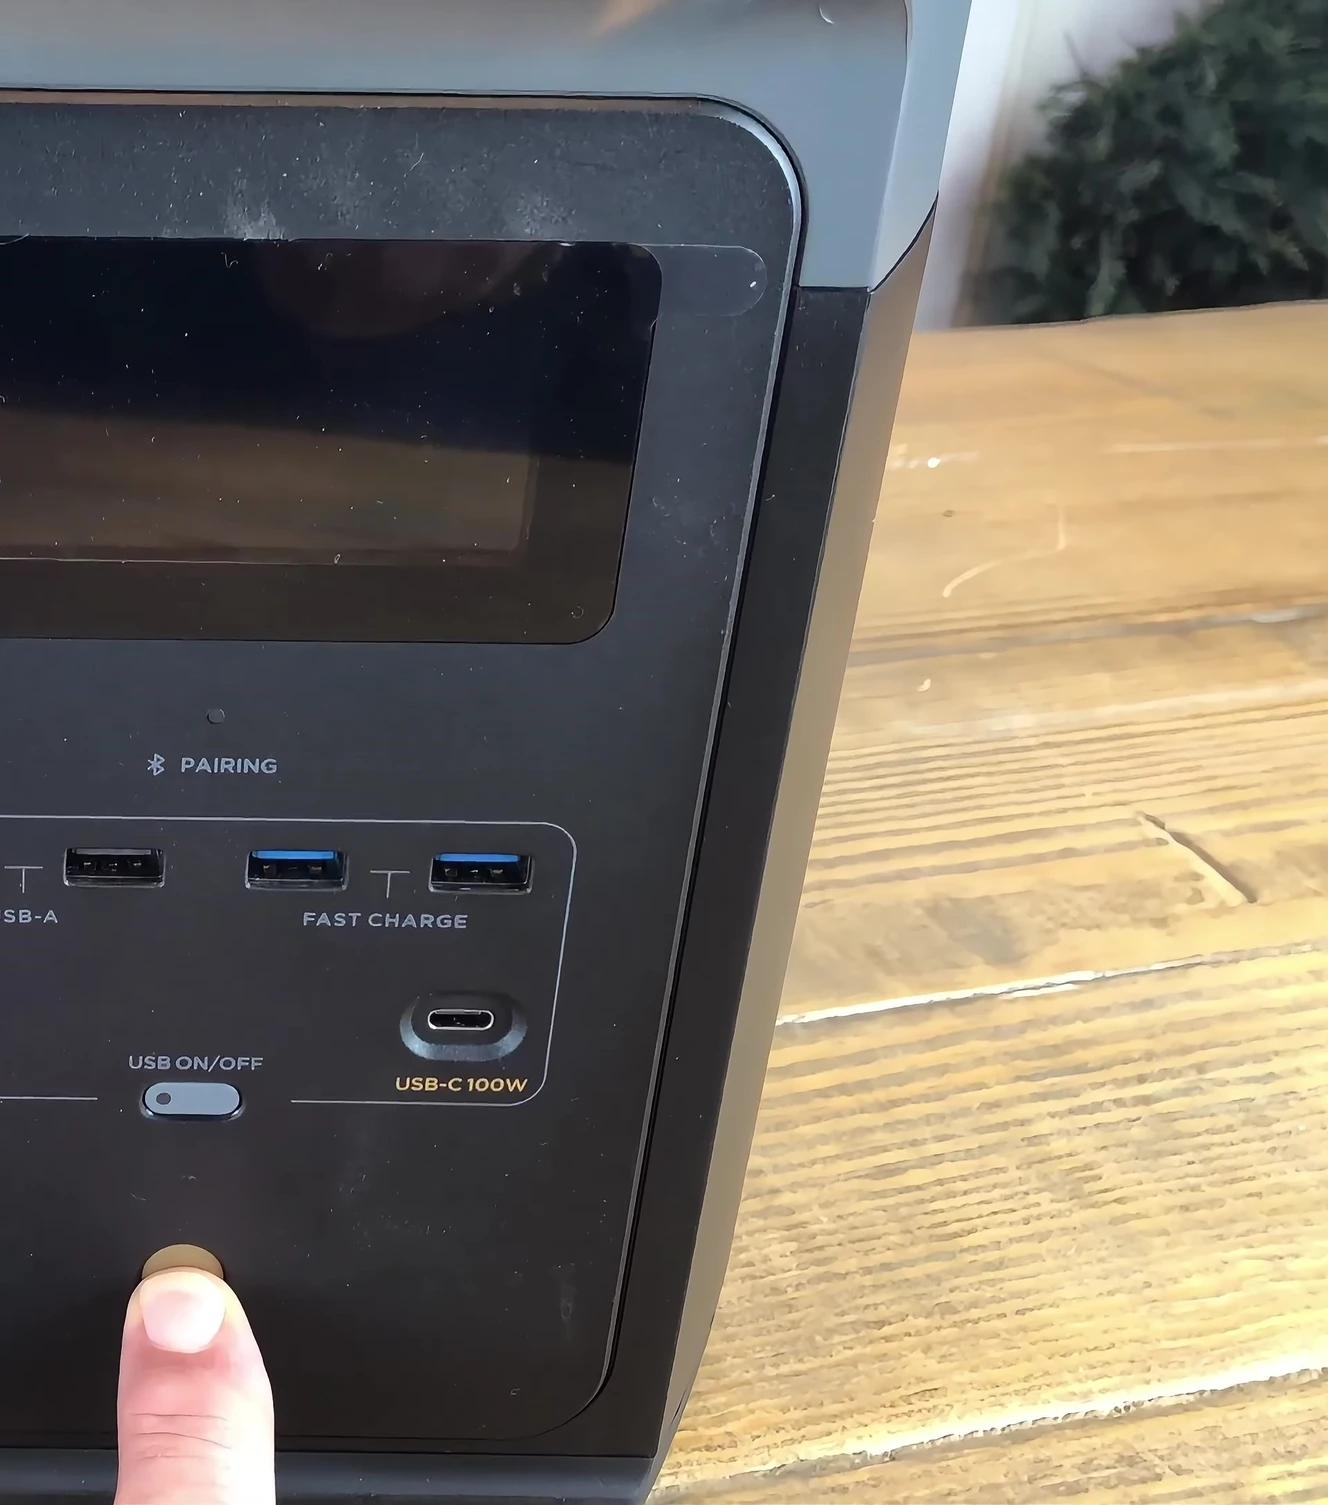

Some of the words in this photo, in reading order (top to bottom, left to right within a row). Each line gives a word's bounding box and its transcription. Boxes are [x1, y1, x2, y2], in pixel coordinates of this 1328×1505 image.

[180, 757, 279, 775] PAIRING
[303, 911, 362, 928] FAST
[367, 912, 469, 930] CHARGE
[128, 1055, 171, 1071] USB
[175, 1055, 265, 1073] ON/OFF
[395, 1076, 463, 1093] USB-C
[467, 1077, 529, 1094] 100W
